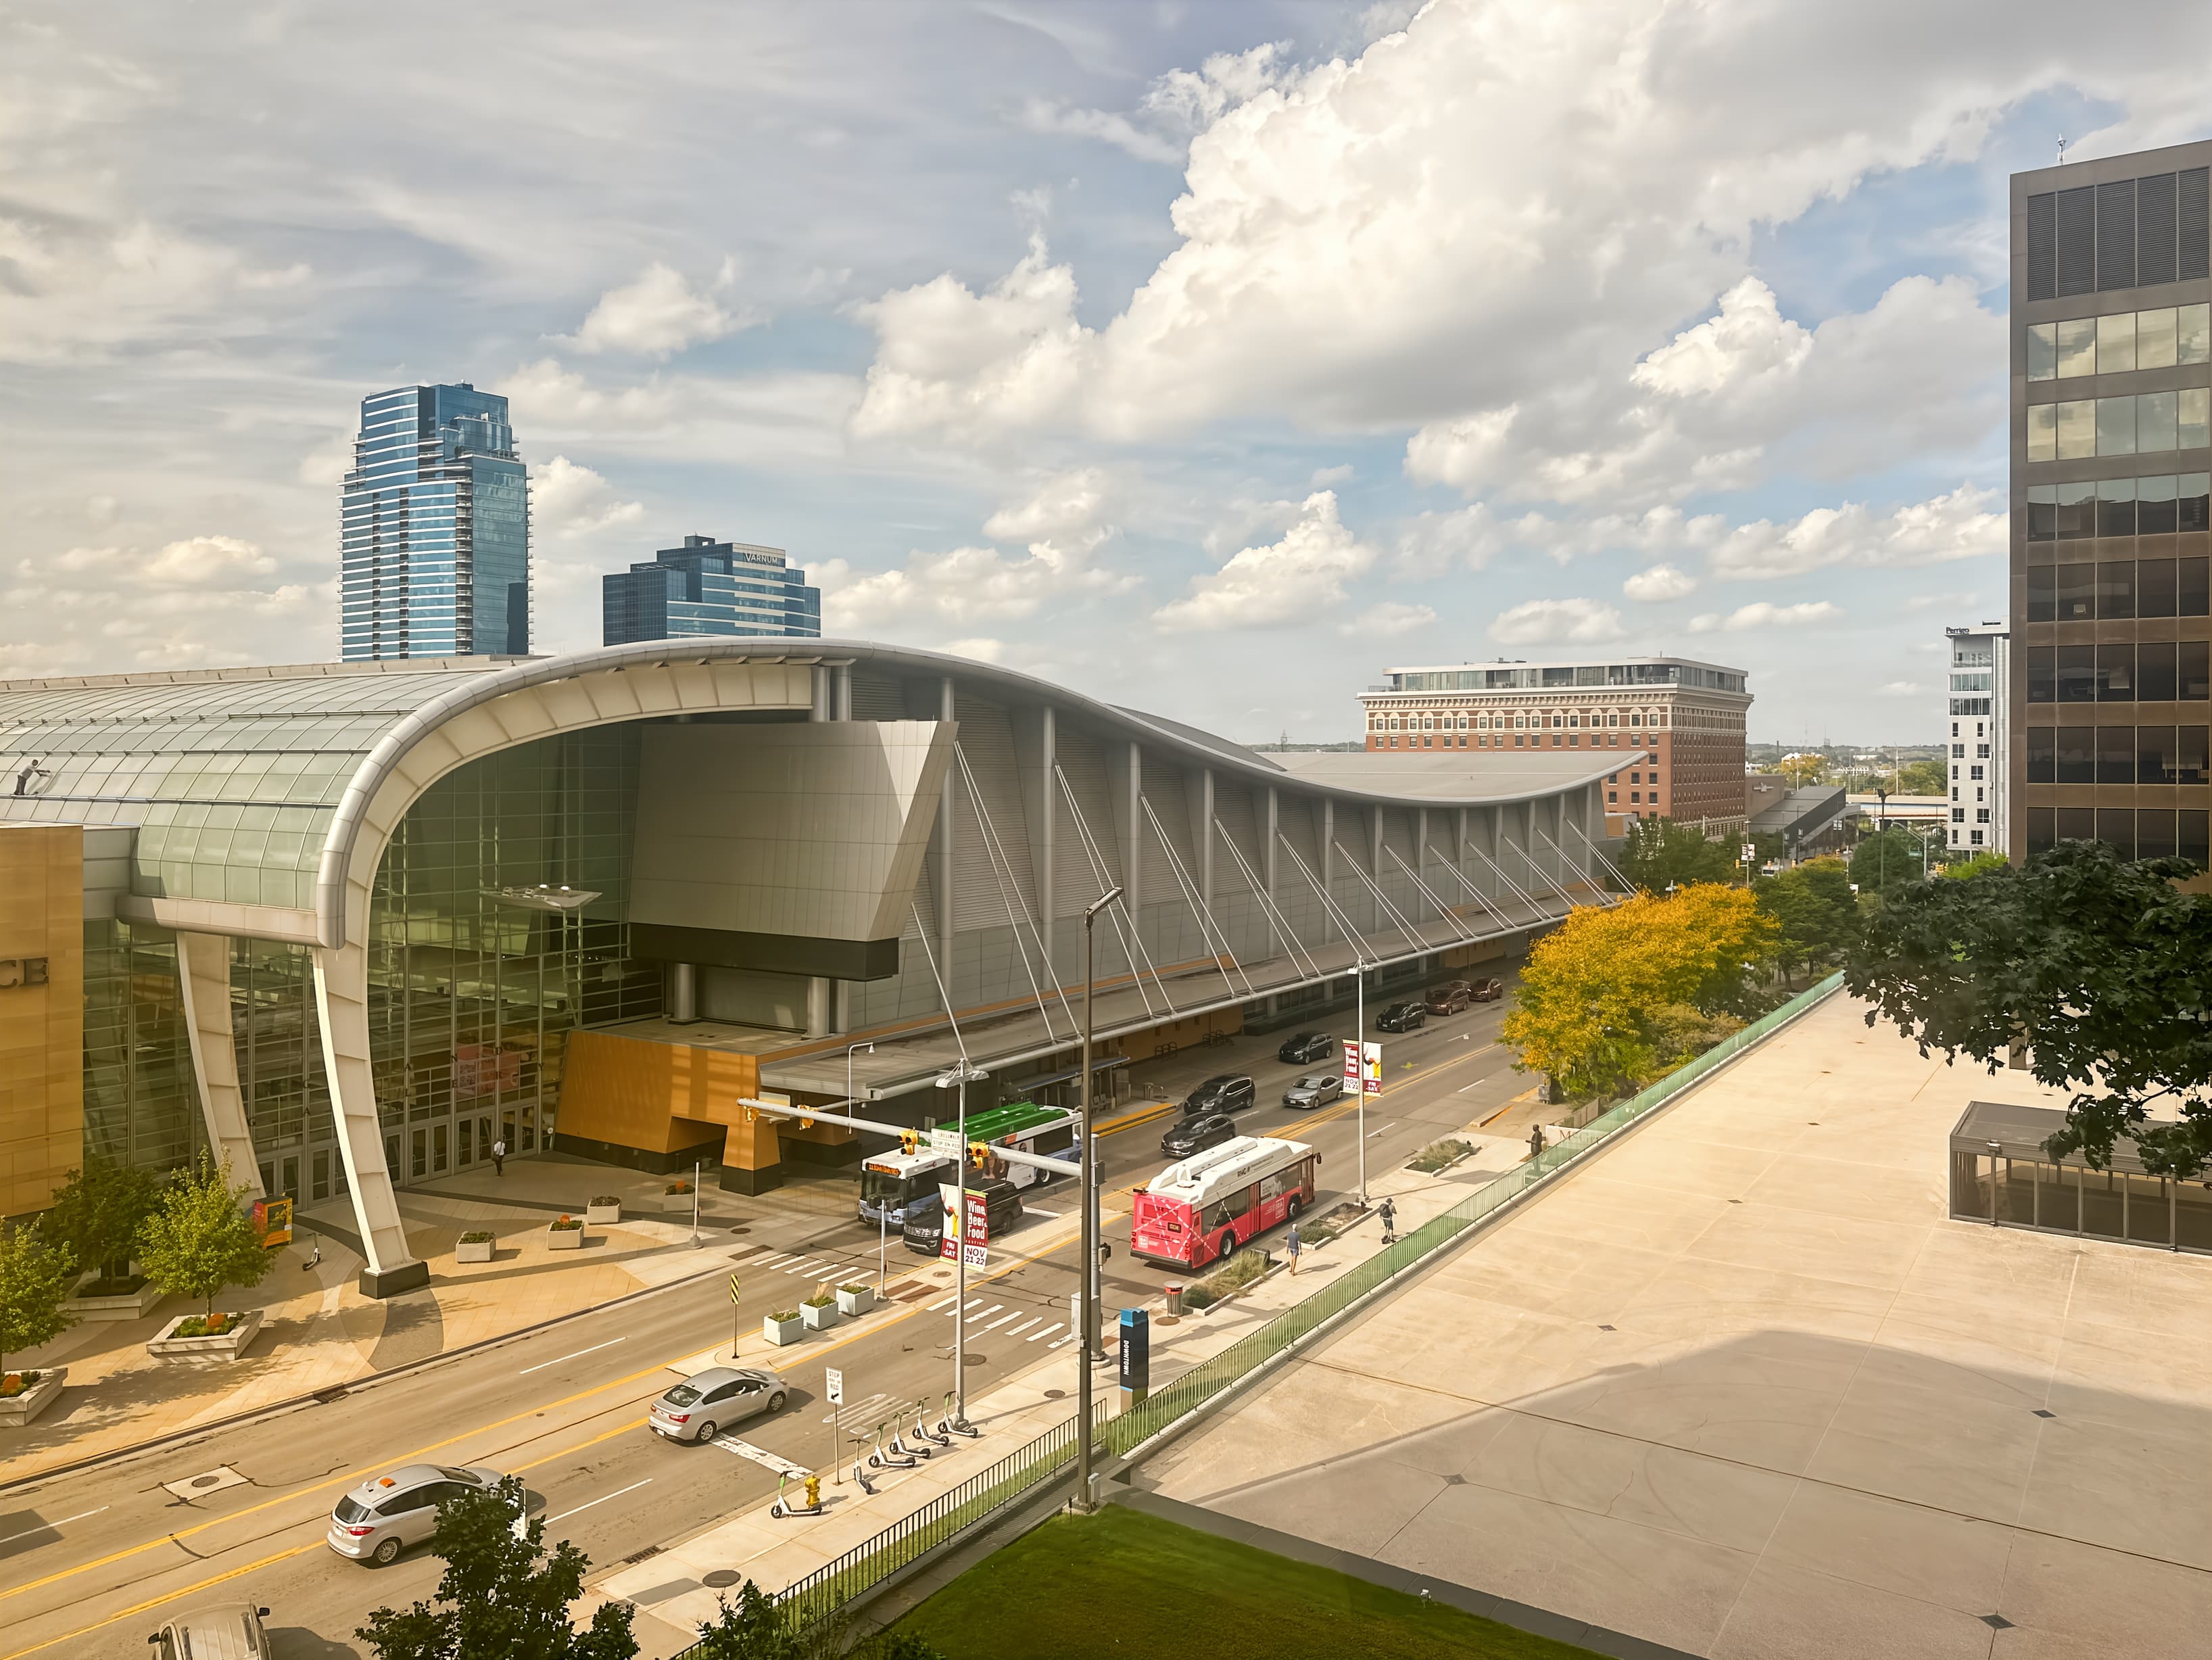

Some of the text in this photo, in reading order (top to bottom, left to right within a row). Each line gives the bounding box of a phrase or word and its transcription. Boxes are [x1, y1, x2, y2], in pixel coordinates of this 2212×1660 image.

[745, 552, 777, 564] VARNUM
[1946, 627, 1969, 635] Perrigo
[967, 1225, 985, 1239] Food
[946, 1241, 955, 1250] FRI
[967, 1247, 985, 1258] NOV
